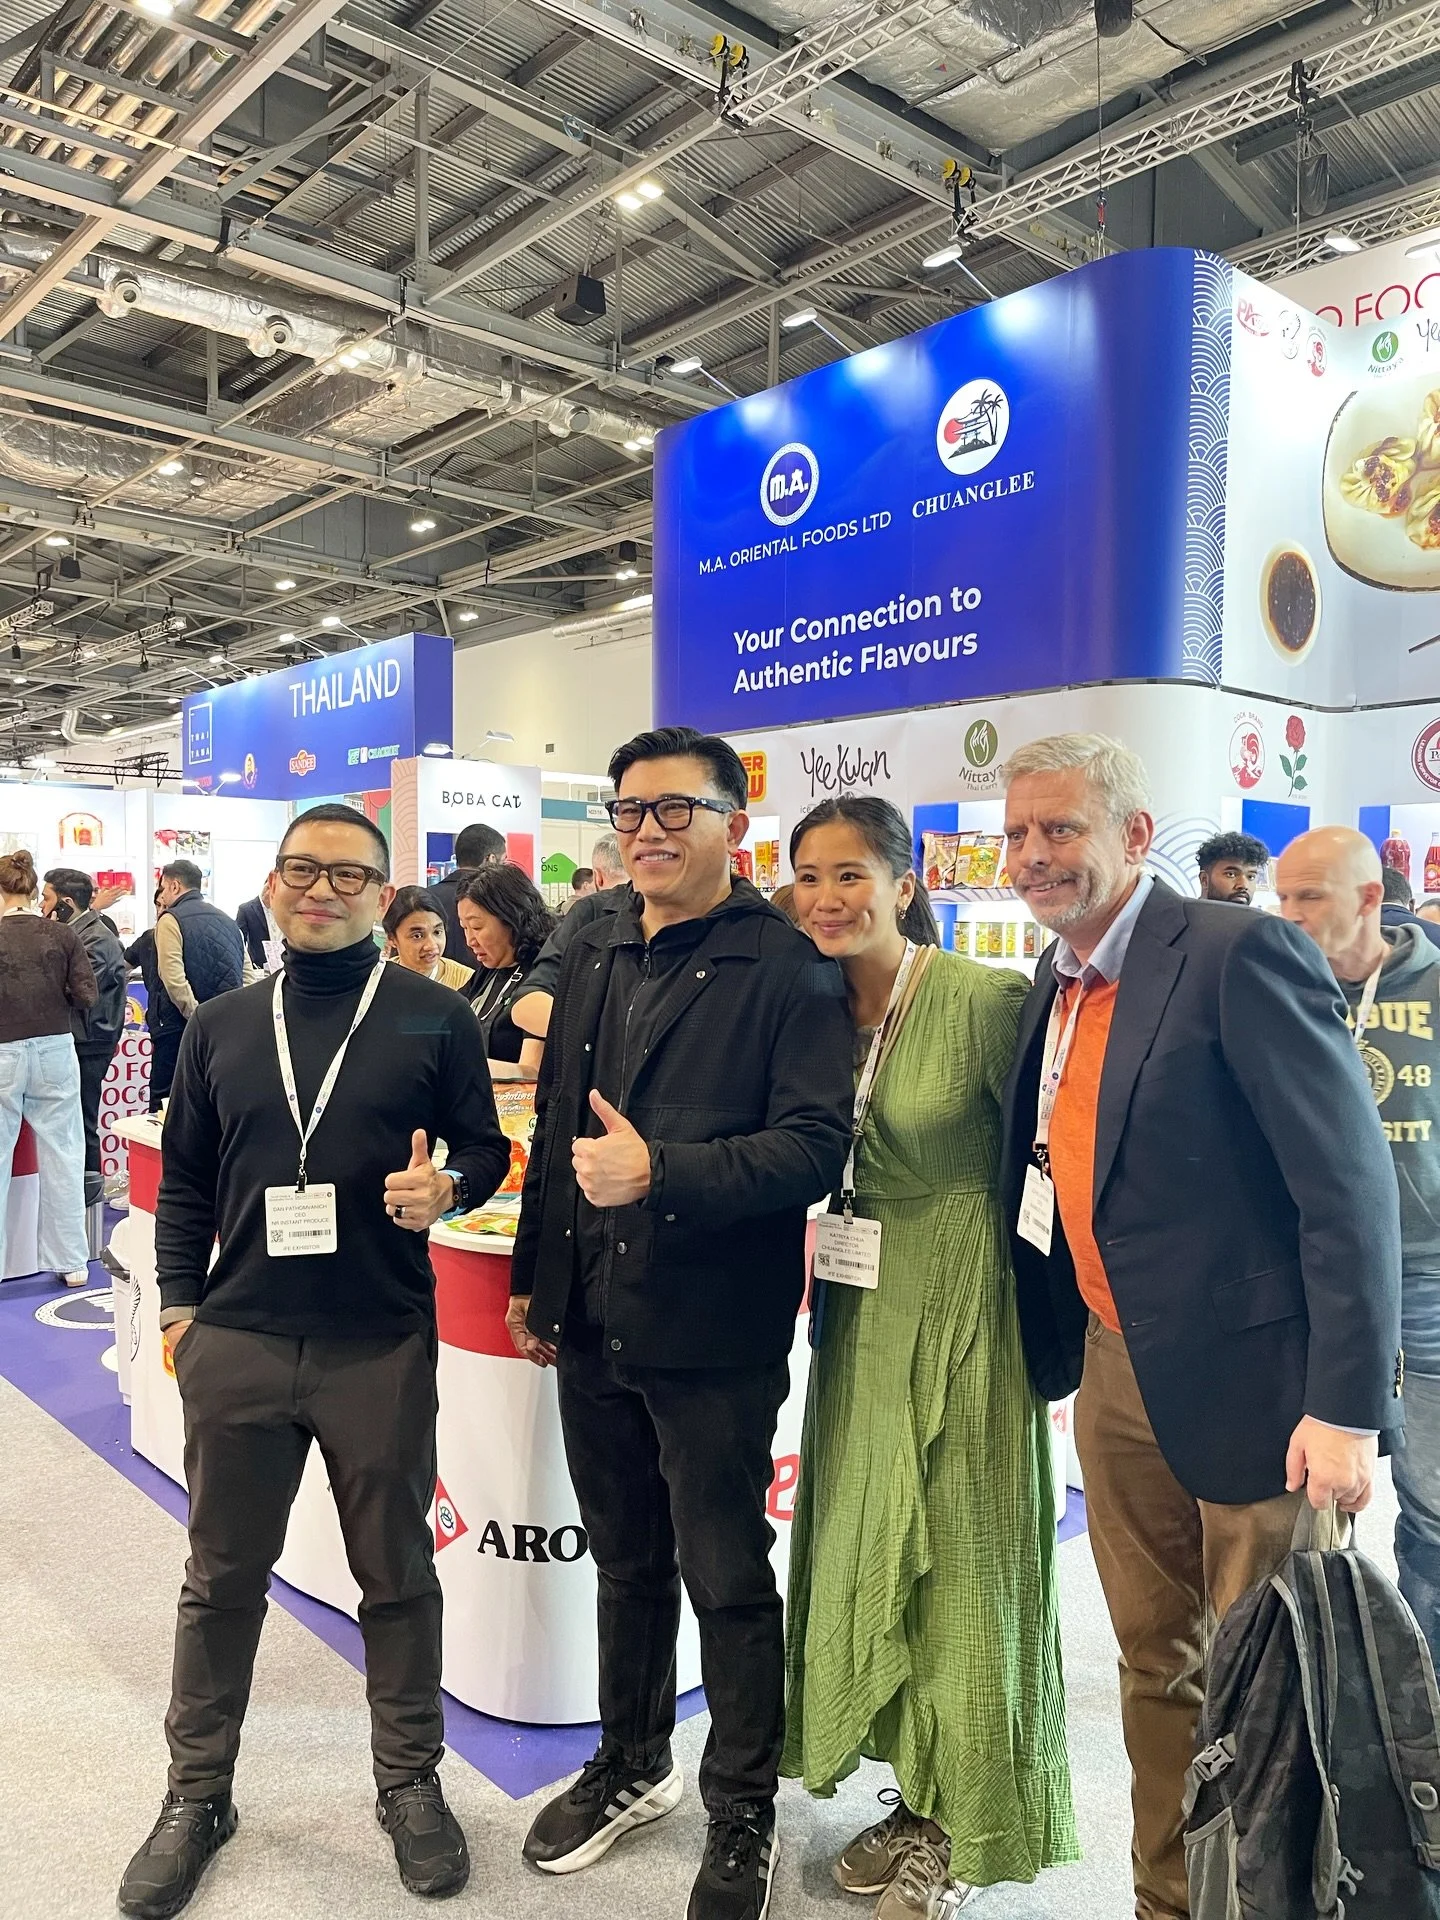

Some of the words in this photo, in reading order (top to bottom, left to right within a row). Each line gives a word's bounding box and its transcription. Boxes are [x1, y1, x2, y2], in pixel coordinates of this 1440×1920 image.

[1416, 318, 1440, 352] Ye
[770, 469, 808, 502] M.A.
[911, 470, 1035, 519] CHUANGLEE
[699, 556, 727, 575] M.A.
[729, 535, 798, 567] ORIENTAL
[802, 520, 858, 548] FOODS
[862, 511, 892, 533] LTD
[733, 627, 784, 655] Your
[790, 593, 942, 644] Connection
[950, 586, 982, 612] to
[733, 650, 853, 694] Authentic
[860, 632, 978, 673] Flavours
[289, 658, 401, 718] THAILAND
[1233, 711, 1247, 724] COCK
[1248, 711, 1264, 729] BRAND
[291, 756, 315, 771] SANDEE
[800, 747, 837, 798] Yee
[837, 744, 891, 795] Kwan
[442, 790, 486, 807] BOBA
[491, 795, 522, 809] CAT
[113, 1037, 154, 1058] CO
[1397, 1064, 1432, 1087] 48
[477, 1519, 590, 1563] ARO
